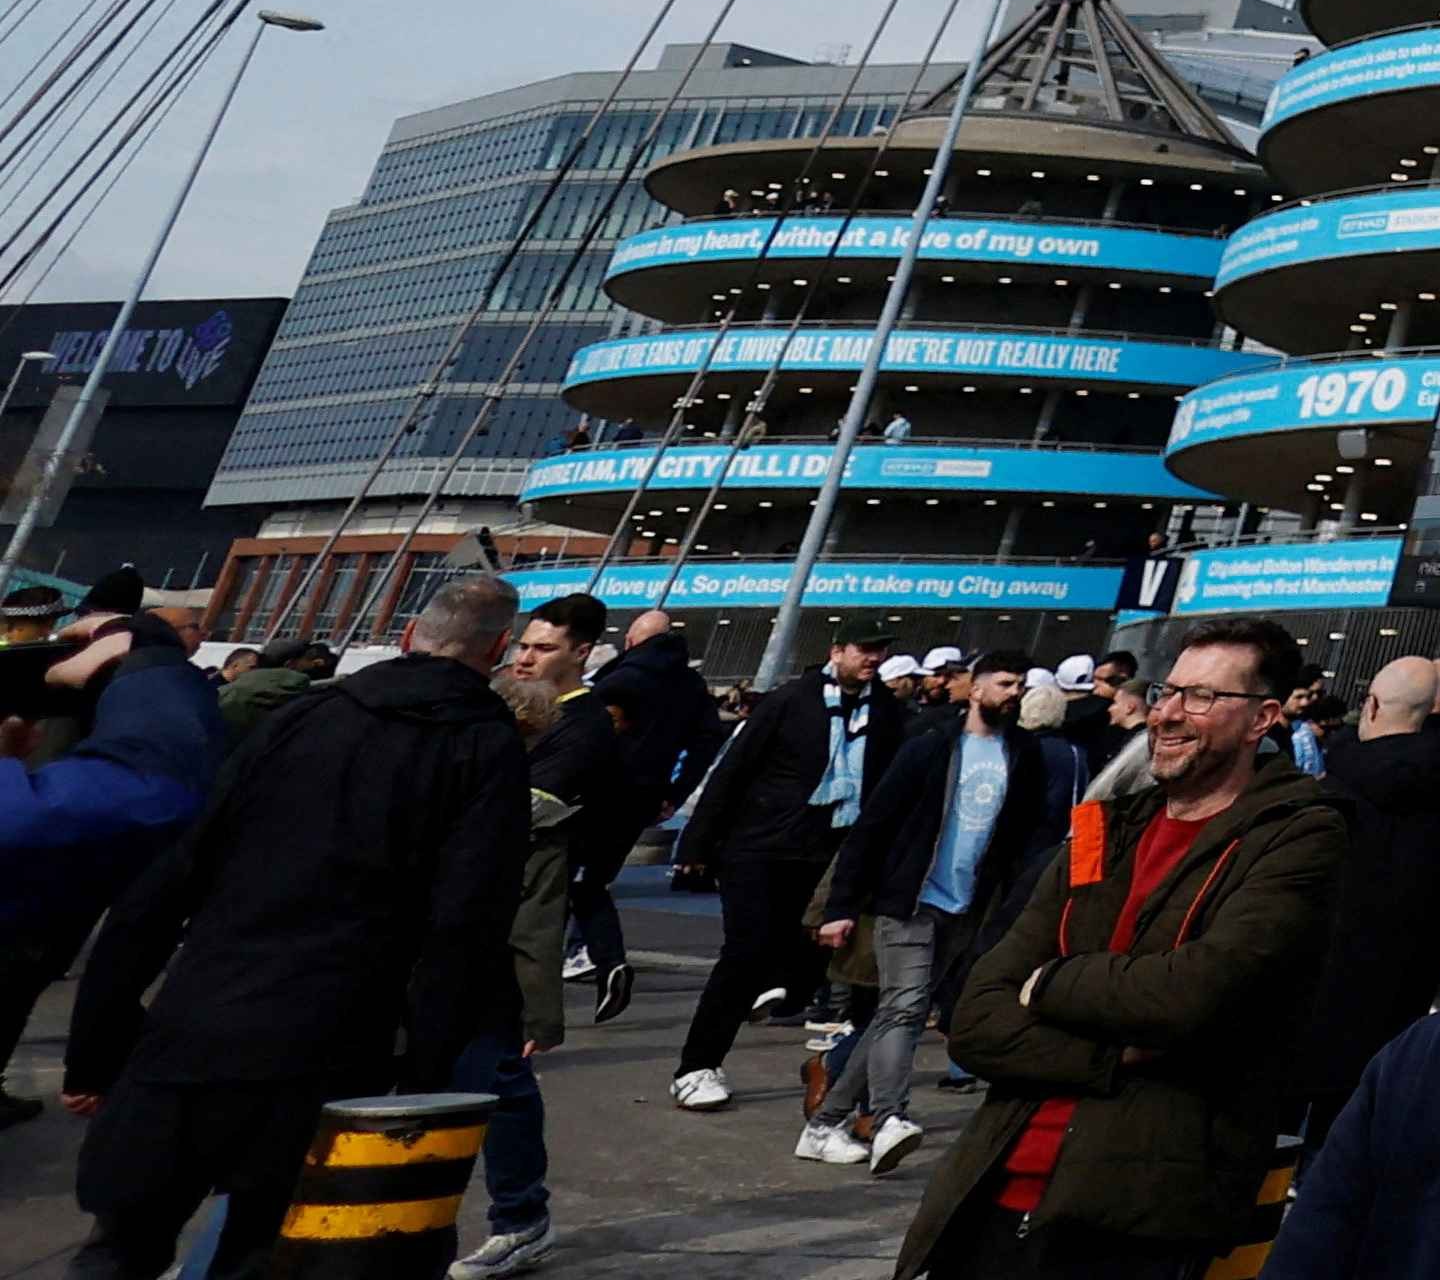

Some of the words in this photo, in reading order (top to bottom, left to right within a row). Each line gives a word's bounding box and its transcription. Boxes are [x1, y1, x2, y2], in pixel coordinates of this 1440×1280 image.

[870, 231, 887, 247] a
[956, 228, 988, 250] of
[988, 235, 1034, 257] my
[1038, 236, 1101, 257] own
[738, 338, 826, 362] INVISIBLE
[888, 337, 951, 364] WE'RE
[955, 339, 998, 365] NOT
[998, 341, 1072, 371] REALLY
[1071, 345, 1124, 374] HERE
[1297, 368, 1407, 420] 1970
[657, 454, 723, 479] CITY
[608, 576, 644, 597] love
[692, 574, 719, 595] So
[863, 573, 914, 595] take
[916, 578, 954, 599] my
[957, 575, 1006, 599] City
[1006, 580, 1069, 601] away
[1138, 559, 1169, 607] V
